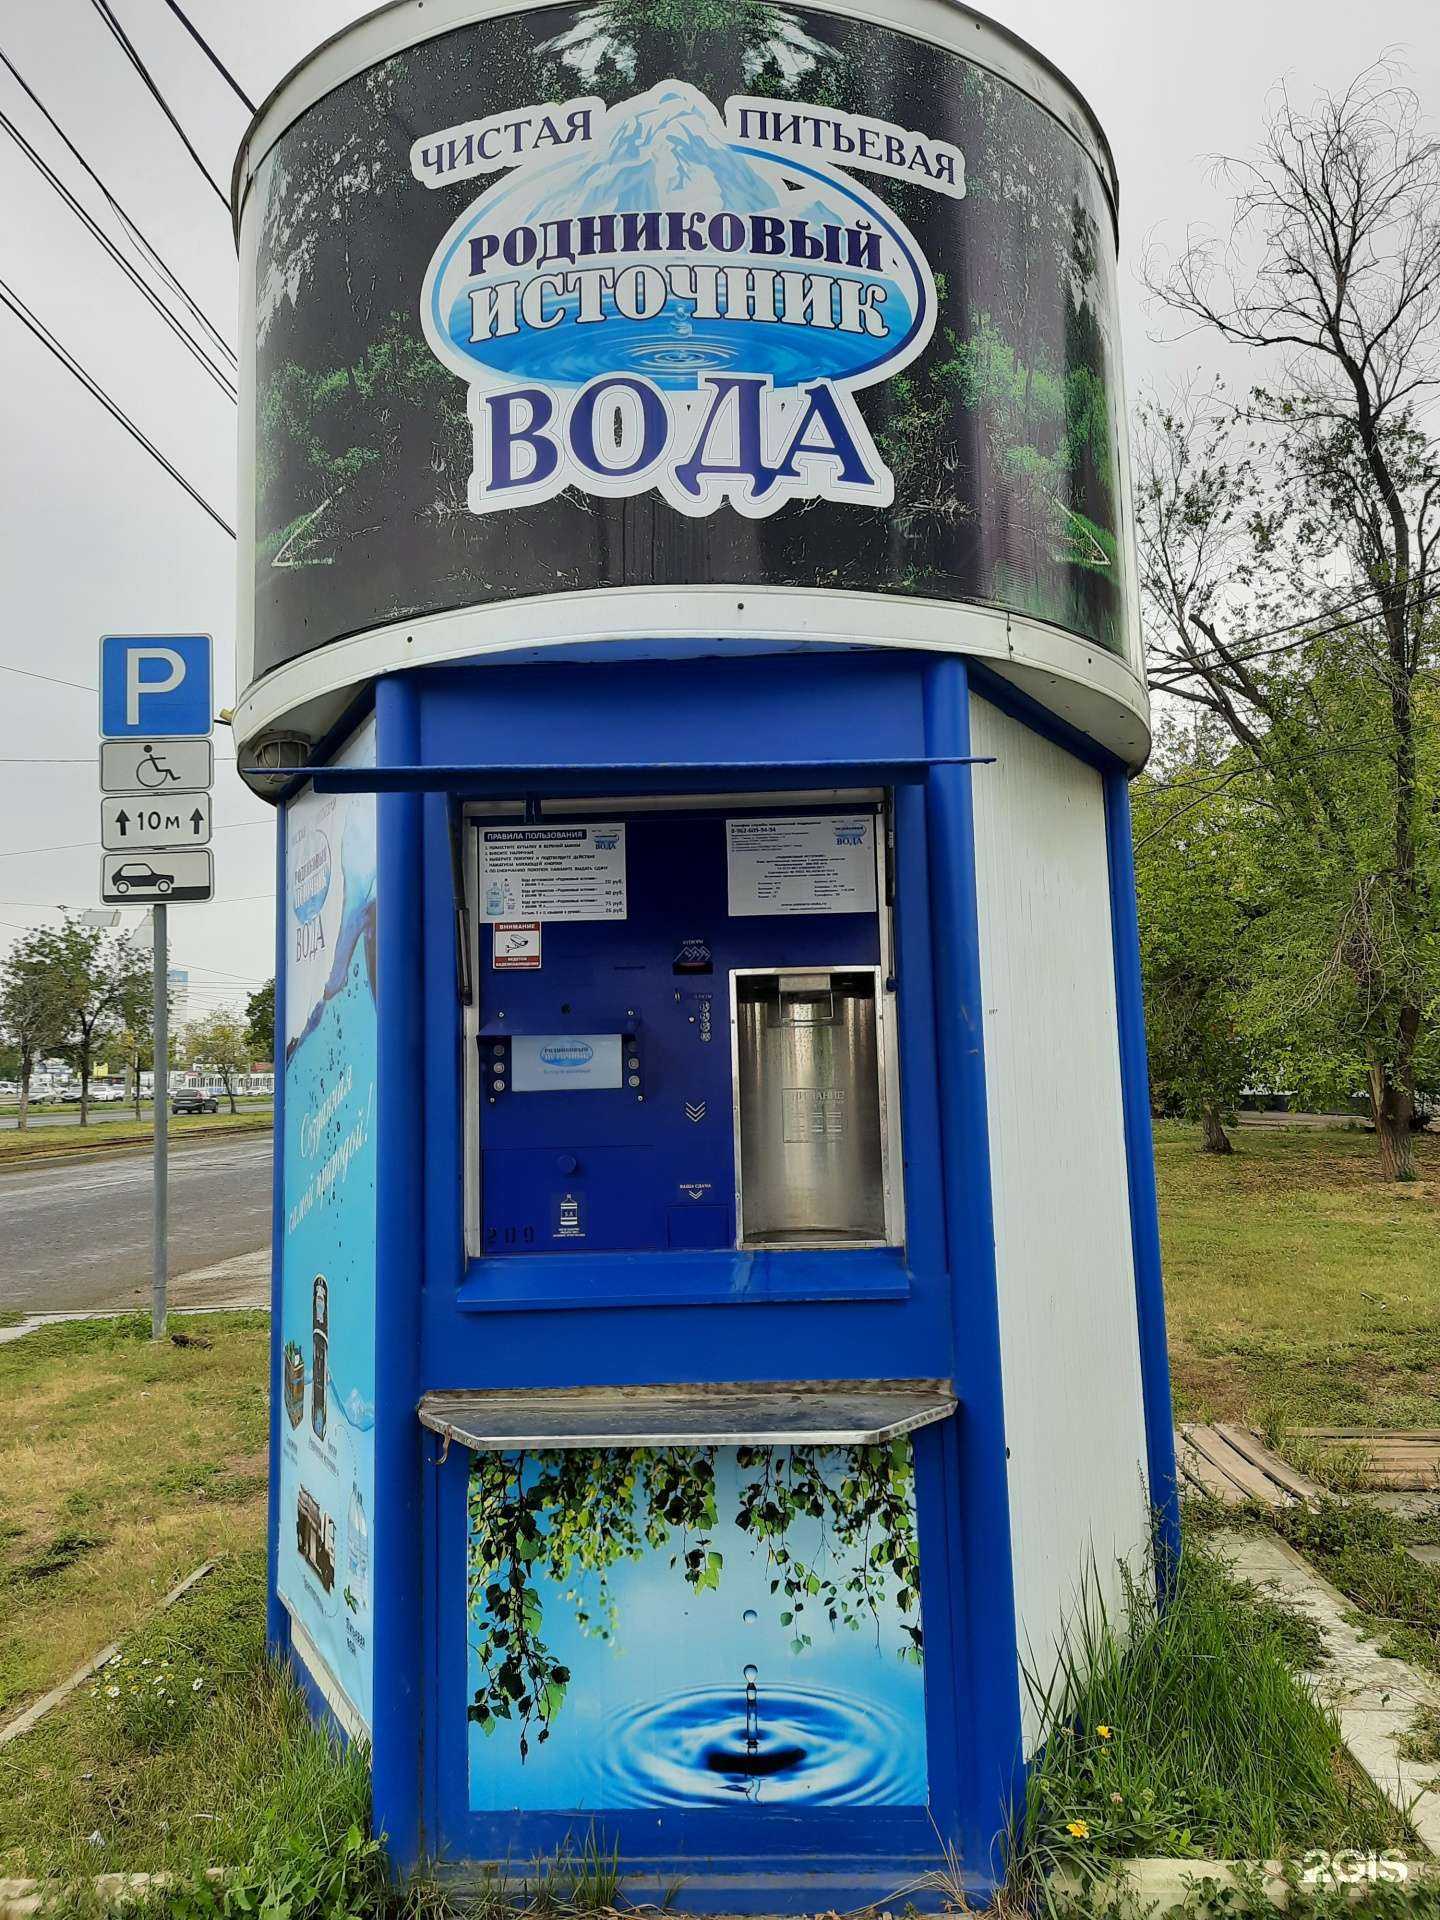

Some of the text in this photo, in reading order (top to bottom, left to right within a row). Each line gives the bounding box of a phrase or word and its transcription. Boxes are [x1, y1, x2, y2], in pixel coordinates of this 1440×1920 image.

[420, 107, 957, 186] ЧИСТАЯ ПИТЬЕВАЯ
[468, 212, 884, 277] РОДНИКОВЫЙ
[468, 263, 892, 345] ИСТОЧНИК
[484, 375, 877, 499] ВОДА
[126, 647, 186, 726] P
[487, 832, 524, 841] ПРАВИЛА
[525, 830, 583, 840] ПОЛЬЗОВАНИЯ
[295, 914, 326, 964] ВОДА
